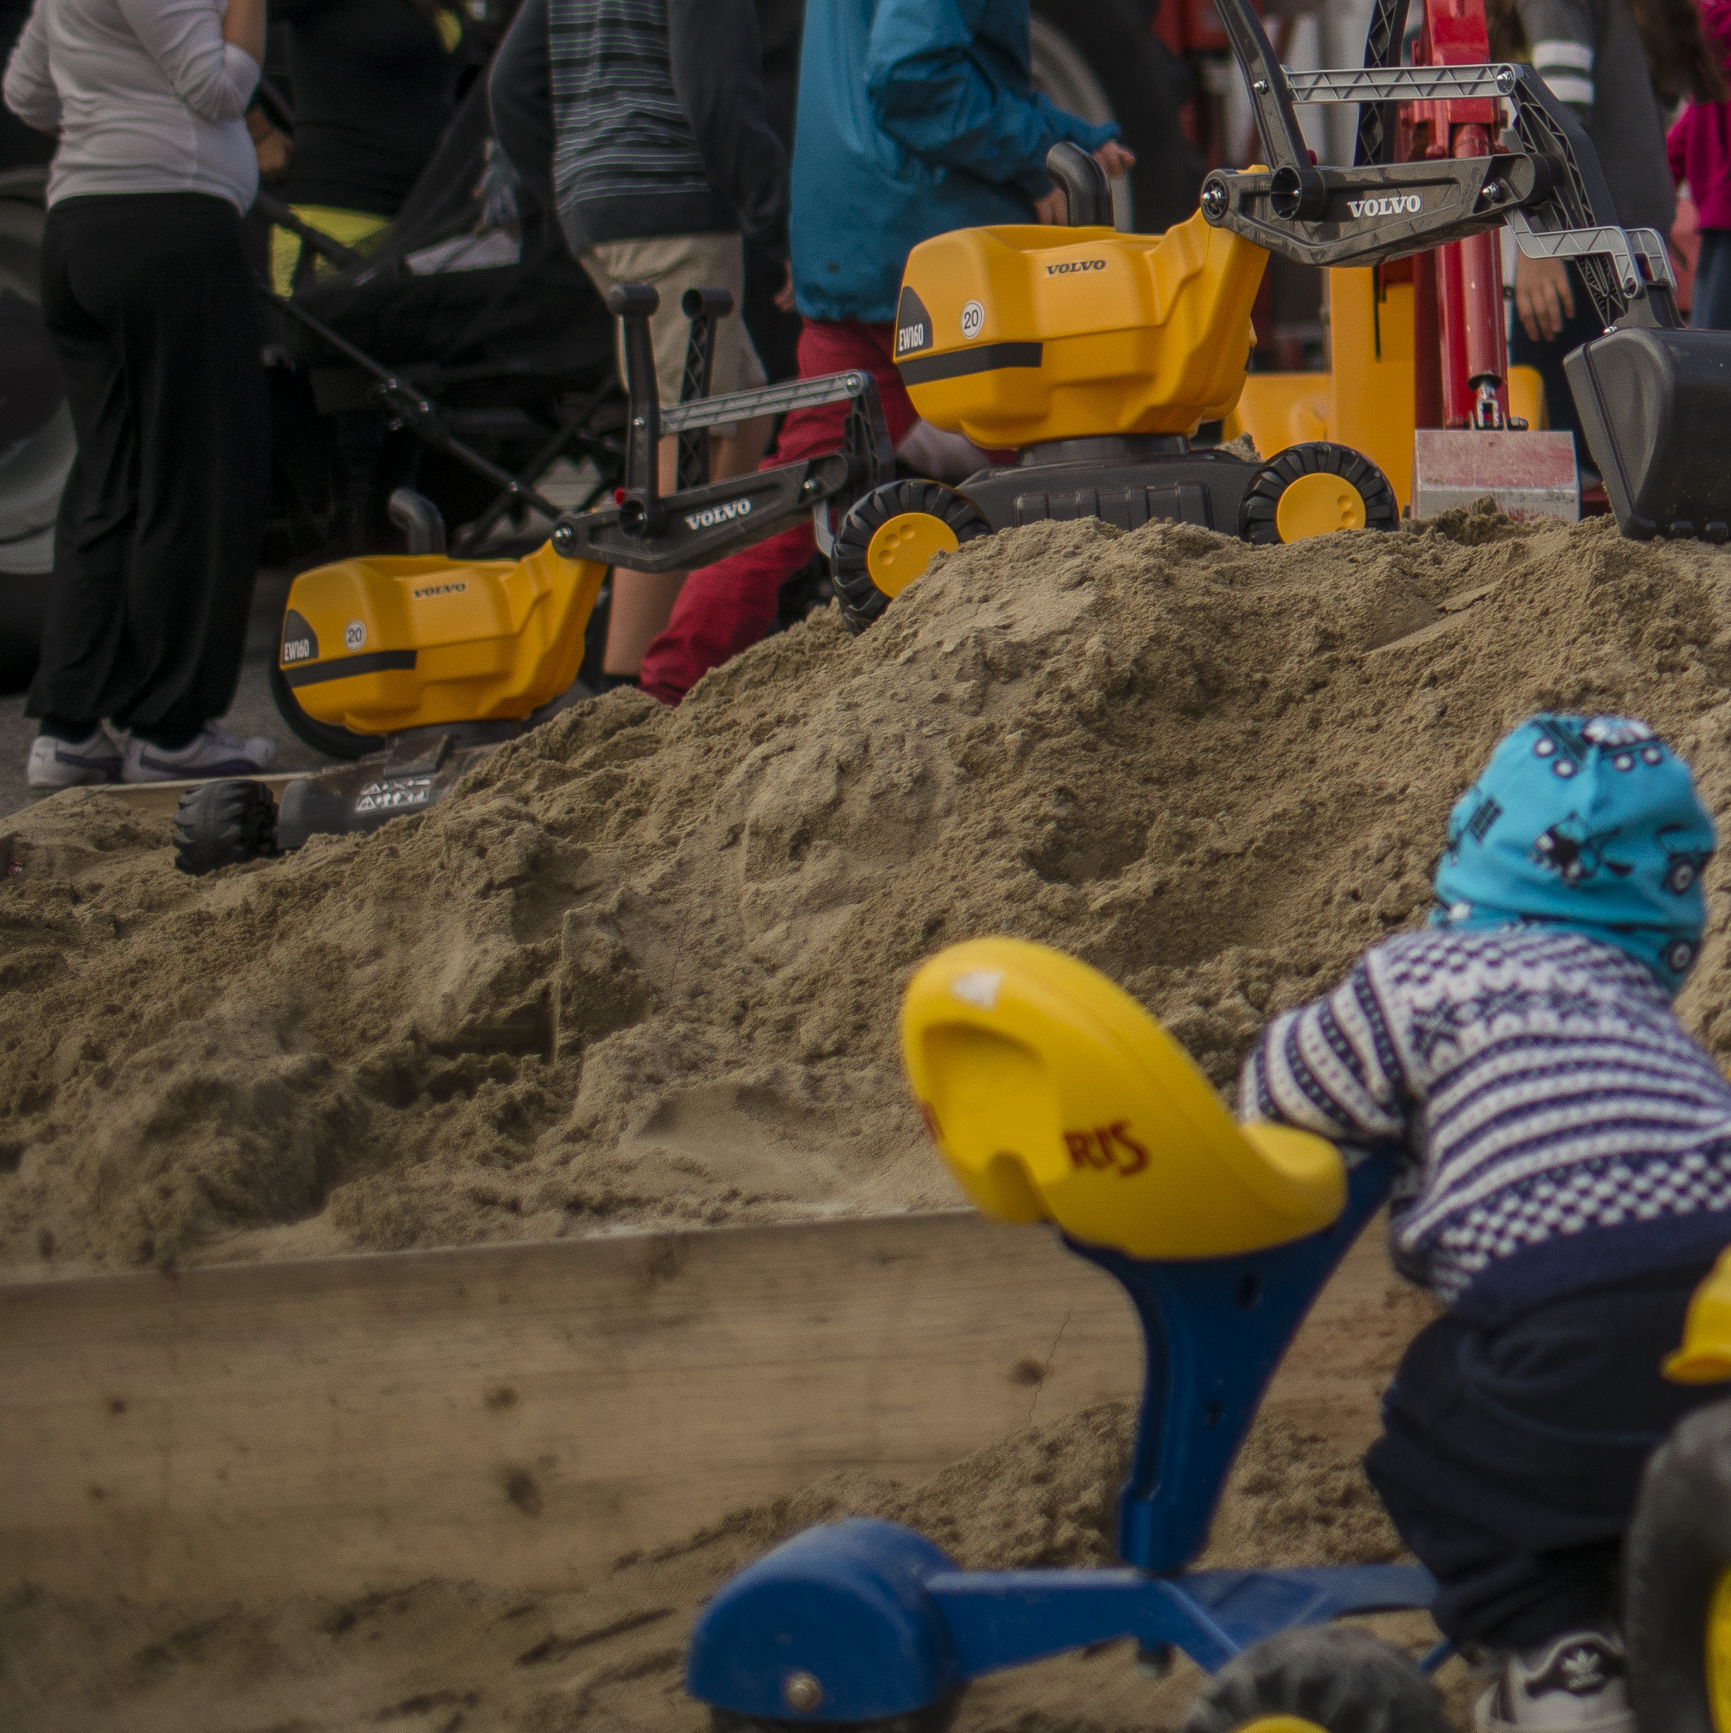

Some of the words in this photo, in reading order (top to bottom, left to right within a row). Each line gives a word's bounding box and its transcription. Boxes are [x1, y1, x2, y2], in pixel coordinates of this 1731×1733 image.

[1347, 194, 1421, 218] VOLVO
[1046, 260, 1106, 276] VOLVO
[963, 309, 979, 330] 20
[899, 323, 924, 352] EW160
[683, 497, 752, 531] VOLVO
[414, 582, 466, 598] VOLVO
[347, 627, 363, 645] 20
[284, 638, 310, 662] EW160
[1063, 1120, 1149, 1176] RIS
